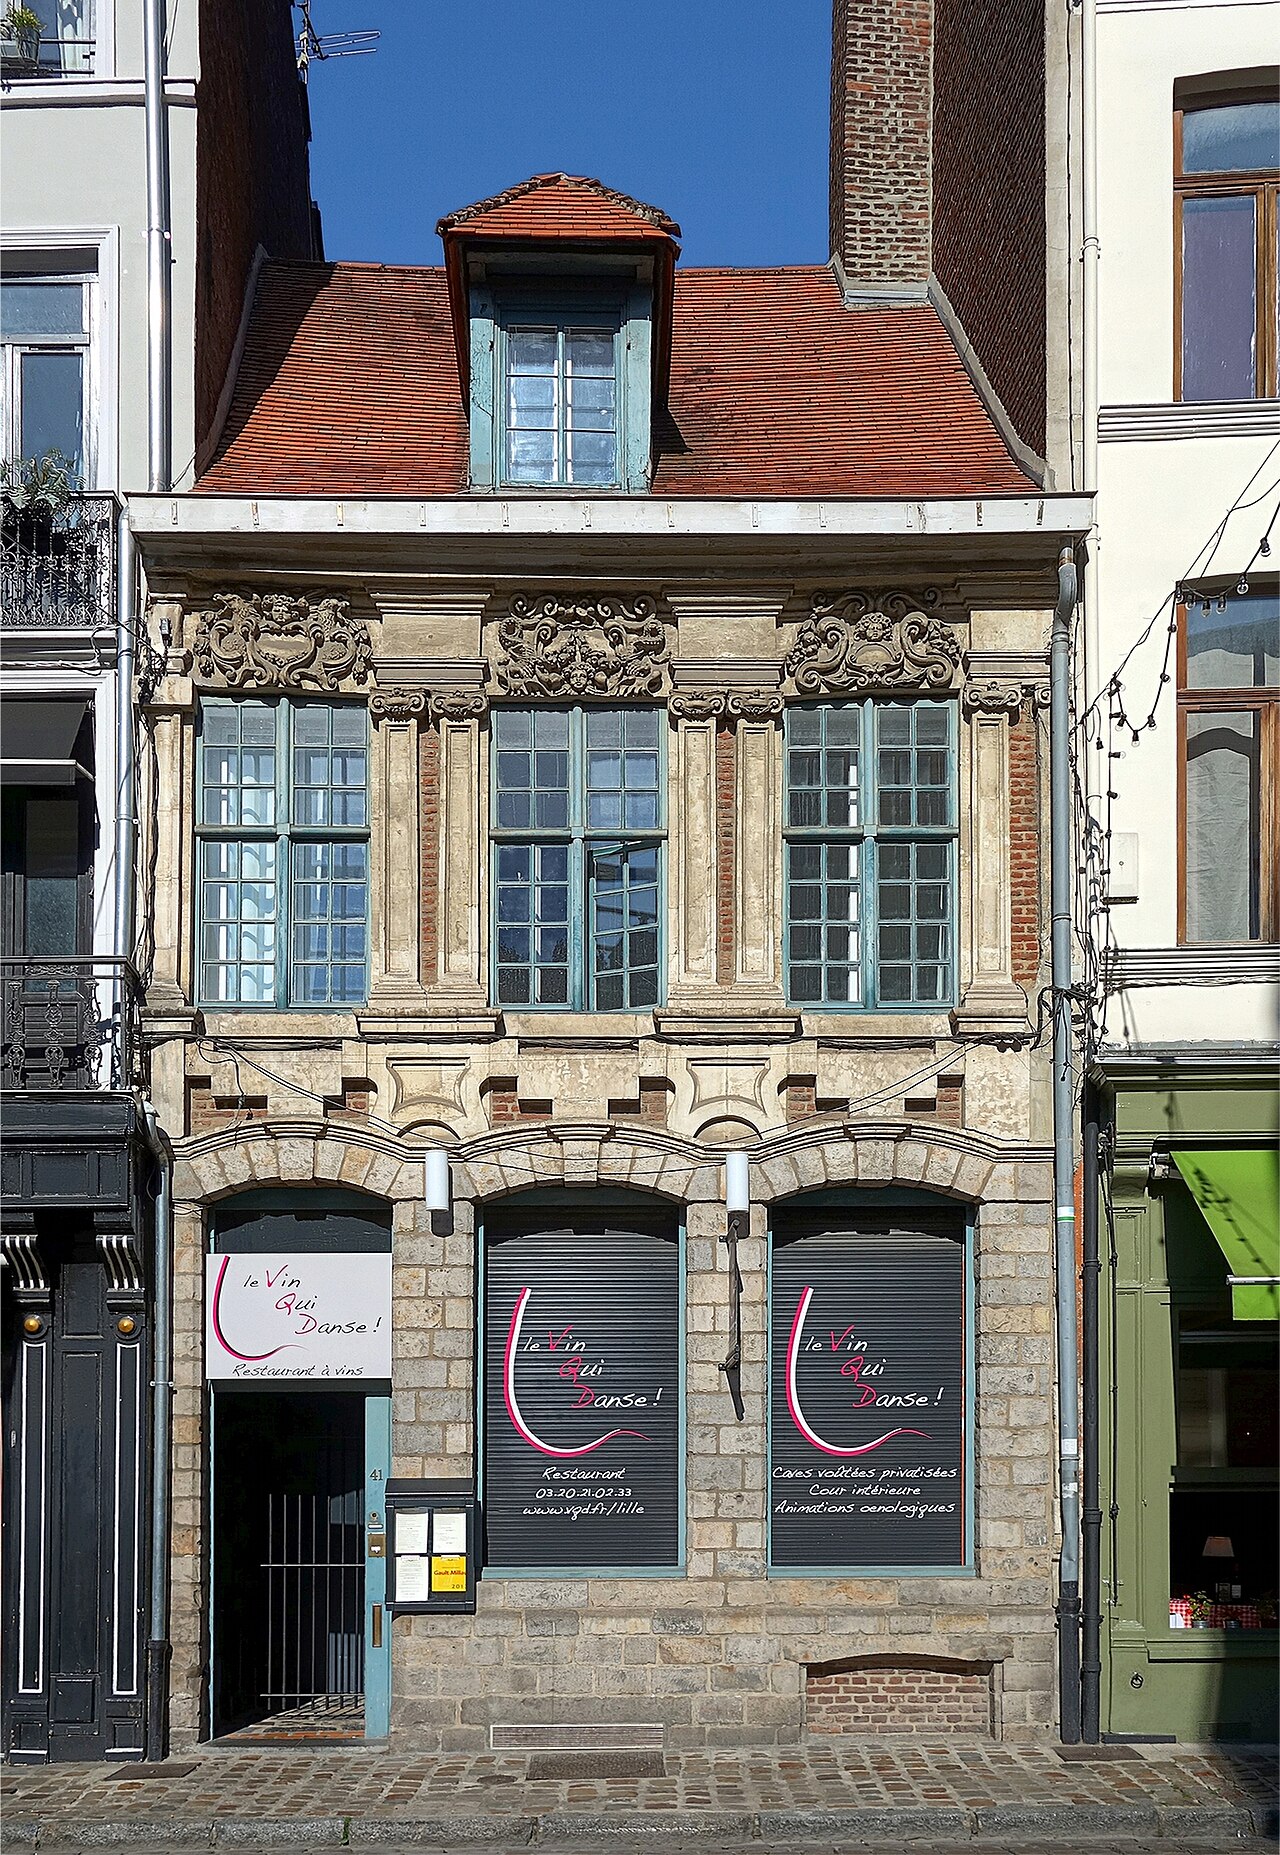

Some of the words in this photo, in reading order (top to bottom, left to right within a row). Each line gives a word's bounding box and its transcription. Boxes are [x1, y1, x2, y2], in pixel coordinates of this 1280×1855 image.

[243, 1274, 259, 1288] le
[266, 1264, 301, 1288] Vin
[275, 1292, 318, 1316] Qui
[523, 1336, 541, 1352] le
[548, 1324, 586, 1352] Vin
[804, 1336, 823, 1351] le
[830, 1324, 868, 1351] Vin
[231, 1363, 316, 1377] Restaurant
[320, 1364, 330, 1376] à
[334, 1364, 364, 1377] vins
[559, 1355, 605, 1384] Qui
[840, 1355, 887, 1382] Qui
[369, 1469, 384, 1482] 41
[542, 1466, 626, 1481] Restaurant
[772, 1466, 813, 1479] Caves
[818, 1464, 876, 1479] voûtées
[878, 1465, 958, 1482] privatisées
[535, 1487, 633, 1499] 03.20.21.02.33
[809, 1483, 847, 1497] Cour
[851, 1484, 922, 1497] intérieure
[774, 1499, 855, 1514] Animations
[859, 1500, 956, 1519] oenologiques
